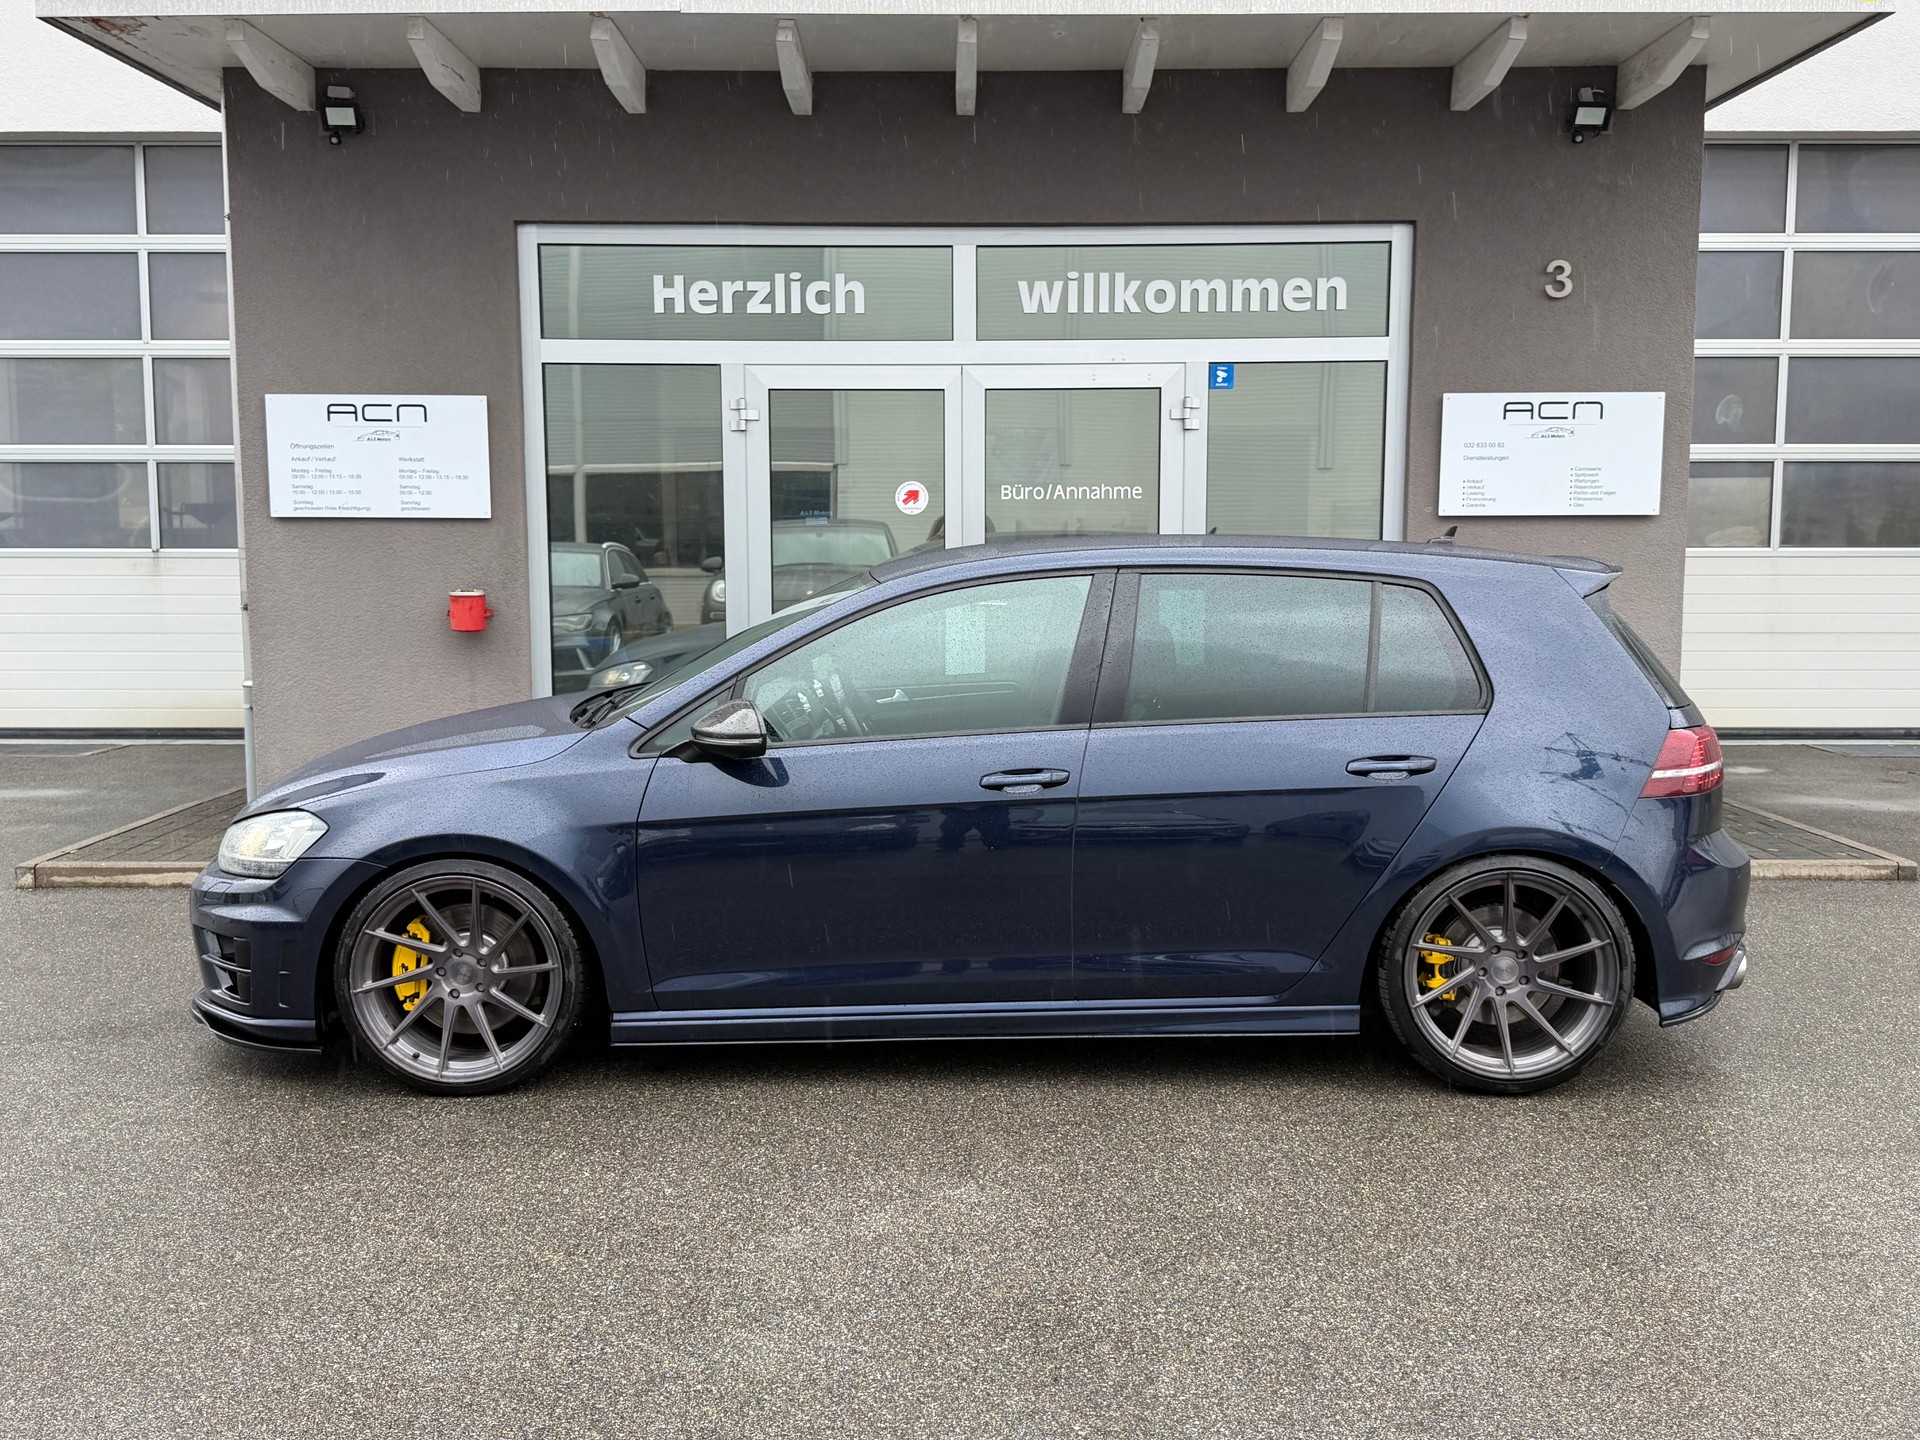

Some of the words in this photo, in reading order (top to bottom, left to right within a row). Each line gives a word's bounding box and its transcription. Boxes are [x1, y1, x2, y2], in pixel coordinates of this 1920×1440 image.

[653, 271, 865, 315] Herzlich
[1017, 270, 1347, 315] willkommen
[1544, 260, 1573, 298] 3
[1000, 484, 1142, 500] Büro/Annahme
